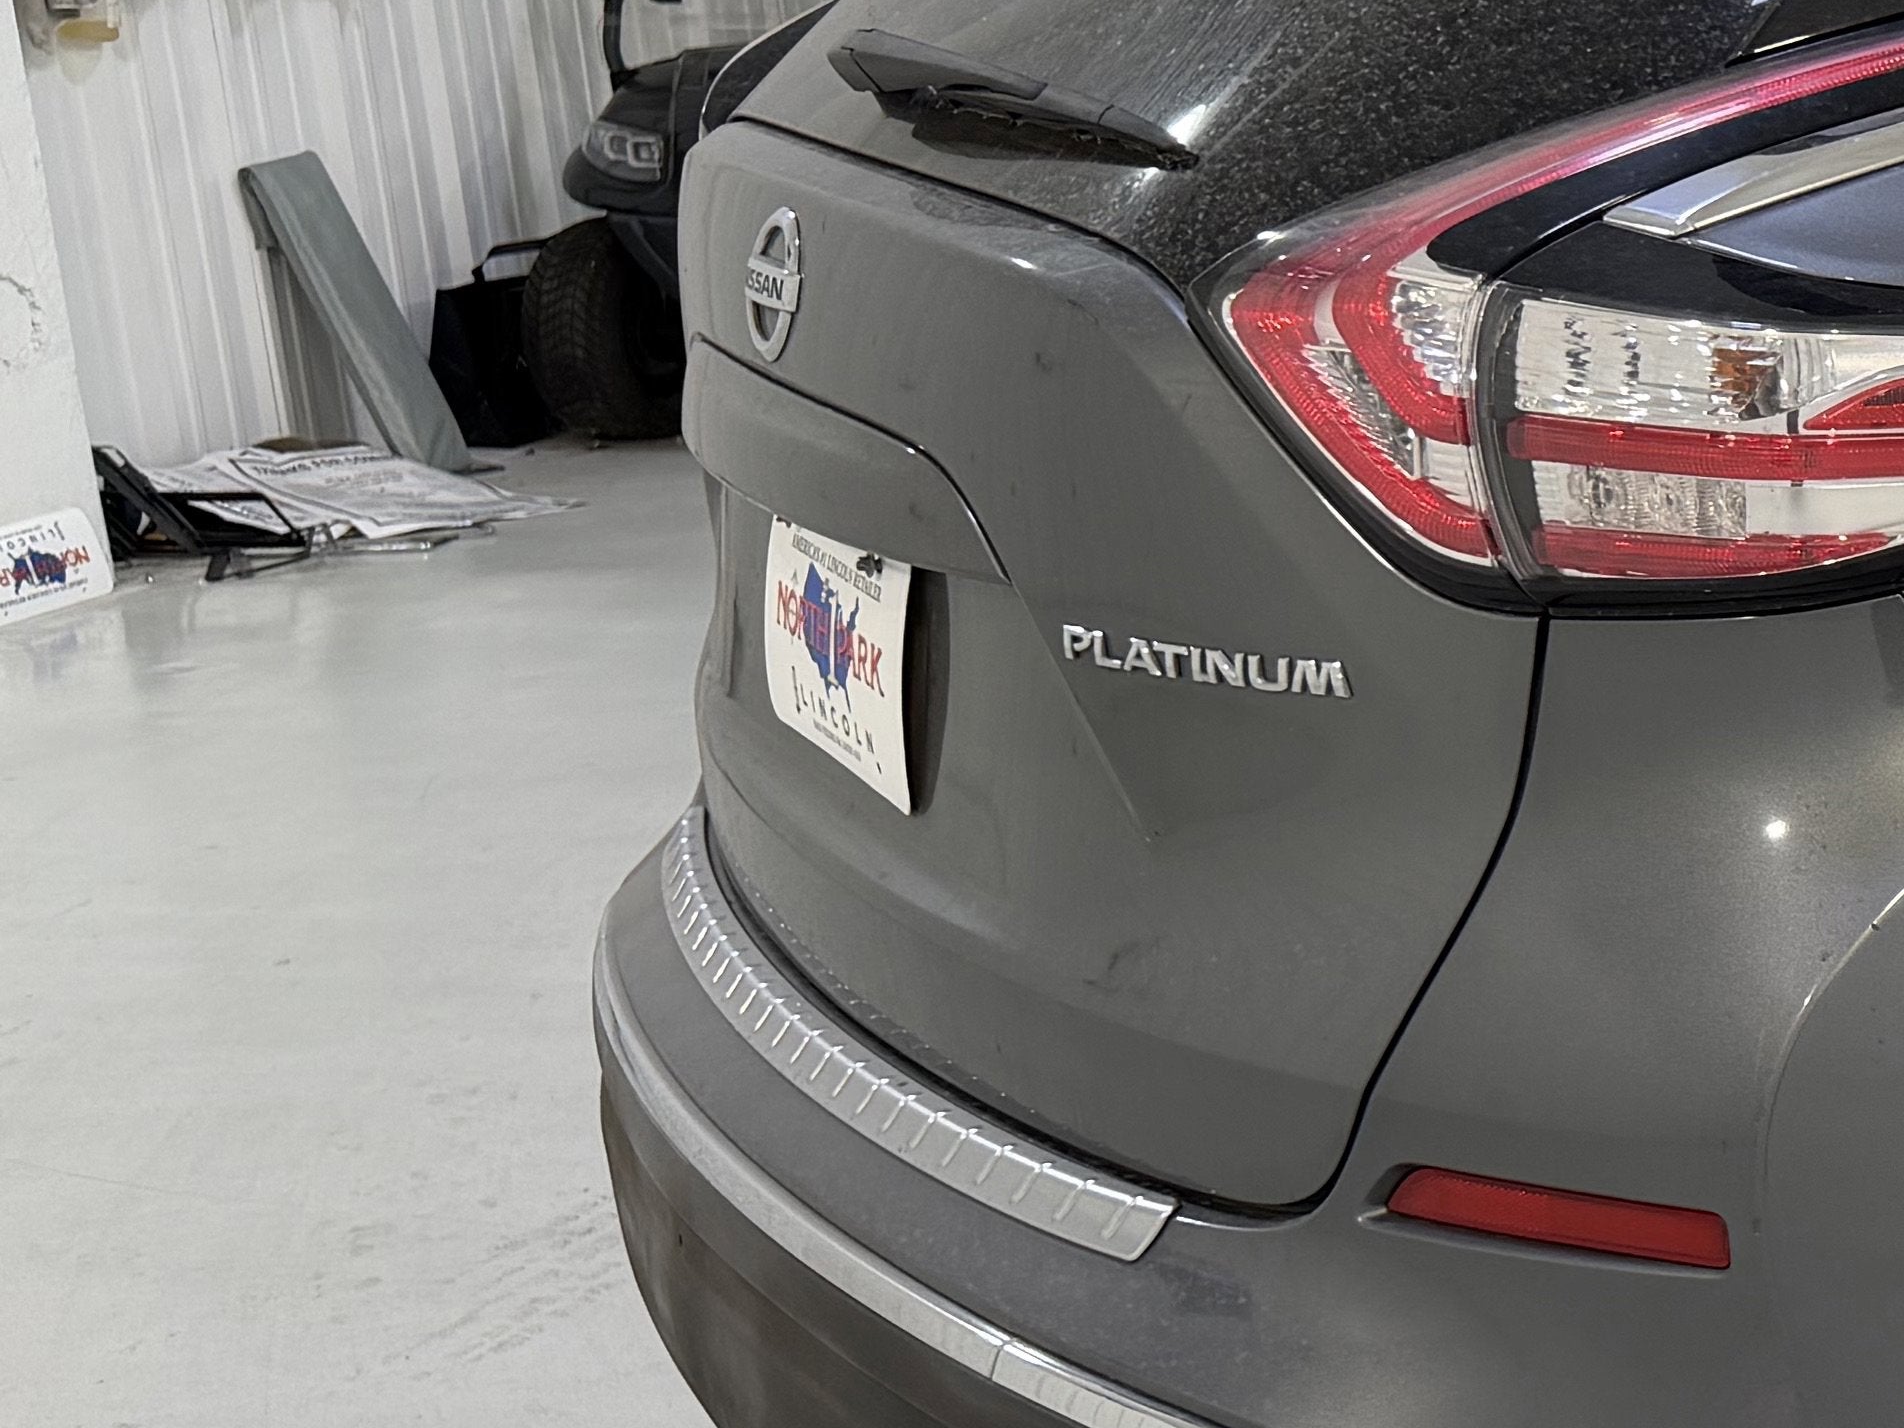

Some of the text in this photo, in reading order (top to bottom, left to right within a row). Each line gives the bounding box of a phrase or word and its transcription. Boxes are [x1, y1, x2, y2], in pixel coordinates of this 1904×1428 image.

[776, 579, 831, 657] NORTH
[834, 621, 885, 698] PARK
[1063, 624, 1352, 698] PLATINUM
[800, 682, 875, 755] LINCOLN
